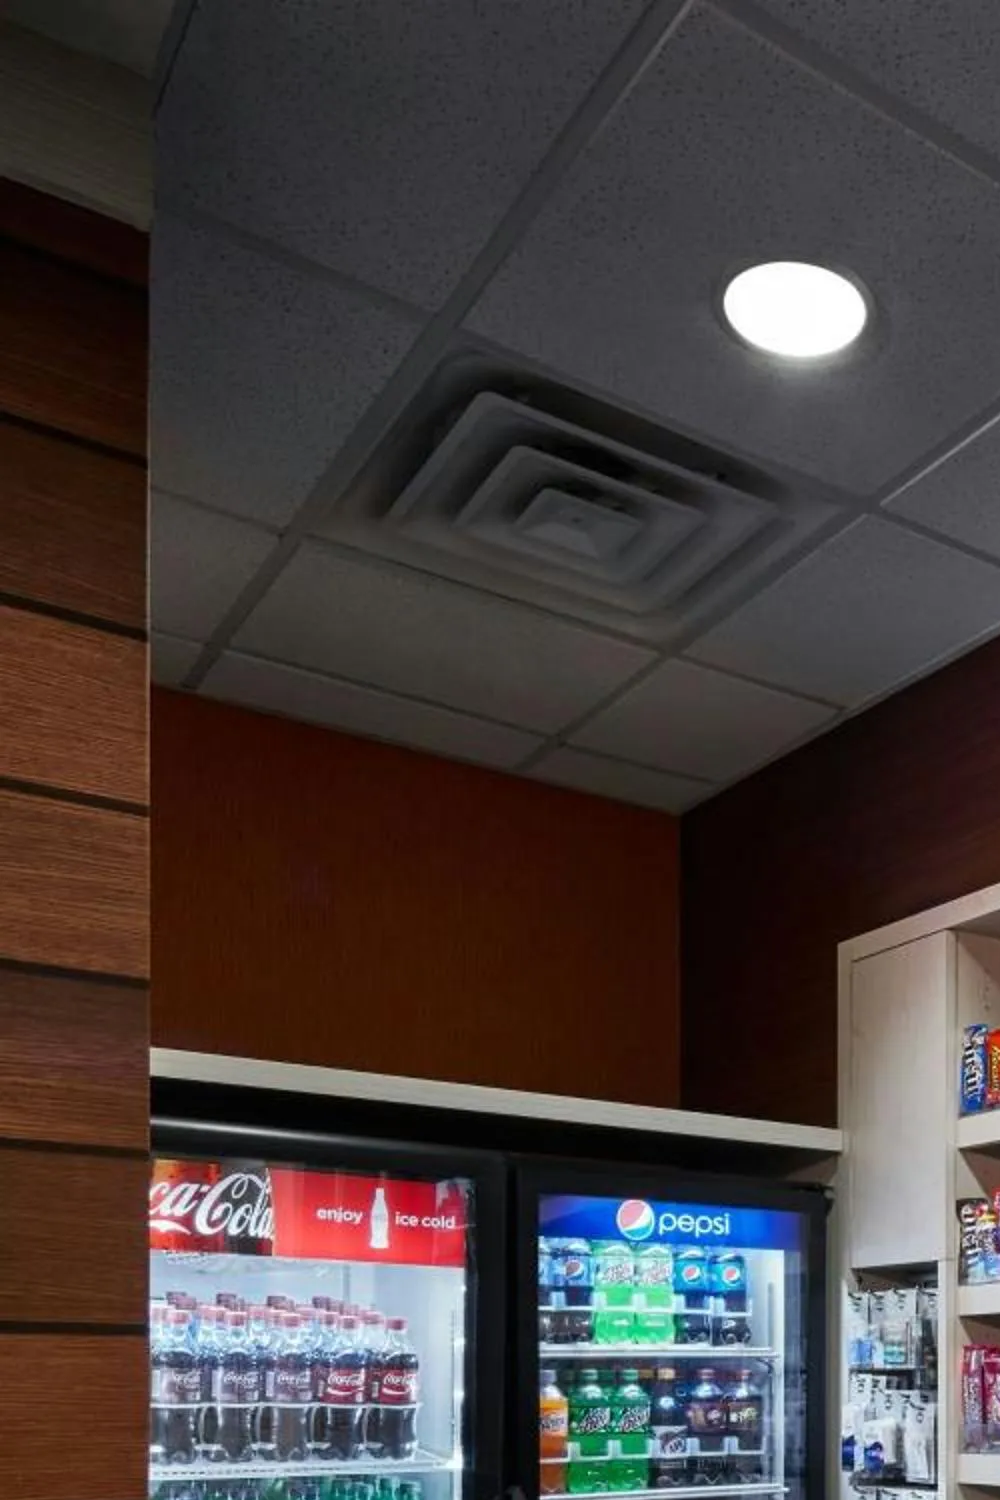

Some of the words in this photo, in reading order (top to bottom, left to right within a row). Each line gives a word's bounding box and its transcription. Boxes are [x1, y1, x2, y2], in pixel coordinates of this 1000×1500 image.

[149, 1172, 275, 1241] ca-Cola
[316, 1206, 363, 1225] enjoy
[395, 1211, 419, 1227] ice
[421, 1214, 456, 1230] cold
[658, 1212, 730, 1238] pepsi
